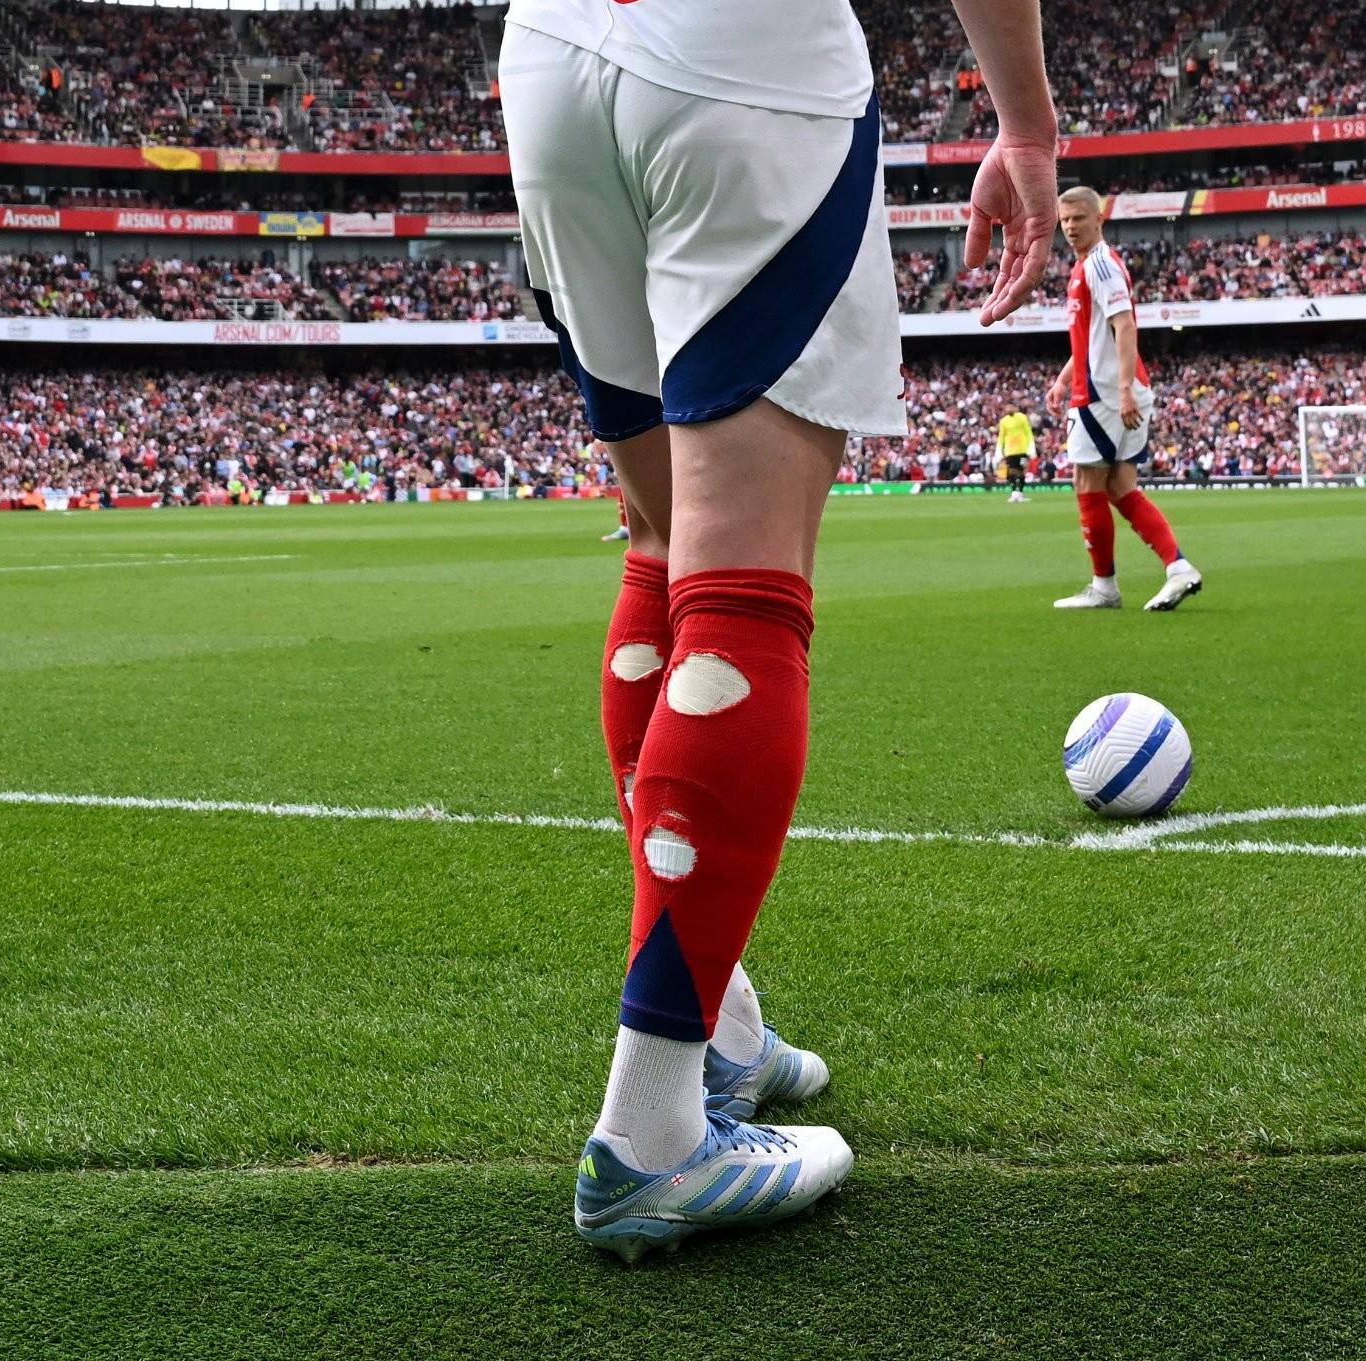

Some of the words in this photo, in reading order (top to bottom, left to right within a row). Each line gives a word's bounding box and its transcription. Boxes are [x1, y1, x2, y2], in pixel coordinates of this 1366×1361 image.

[1266, 187, 1327, 208] Arsenal
[1, 208, 60, 228] Arsenal
[609, 1181, 635, 1199] COPA
